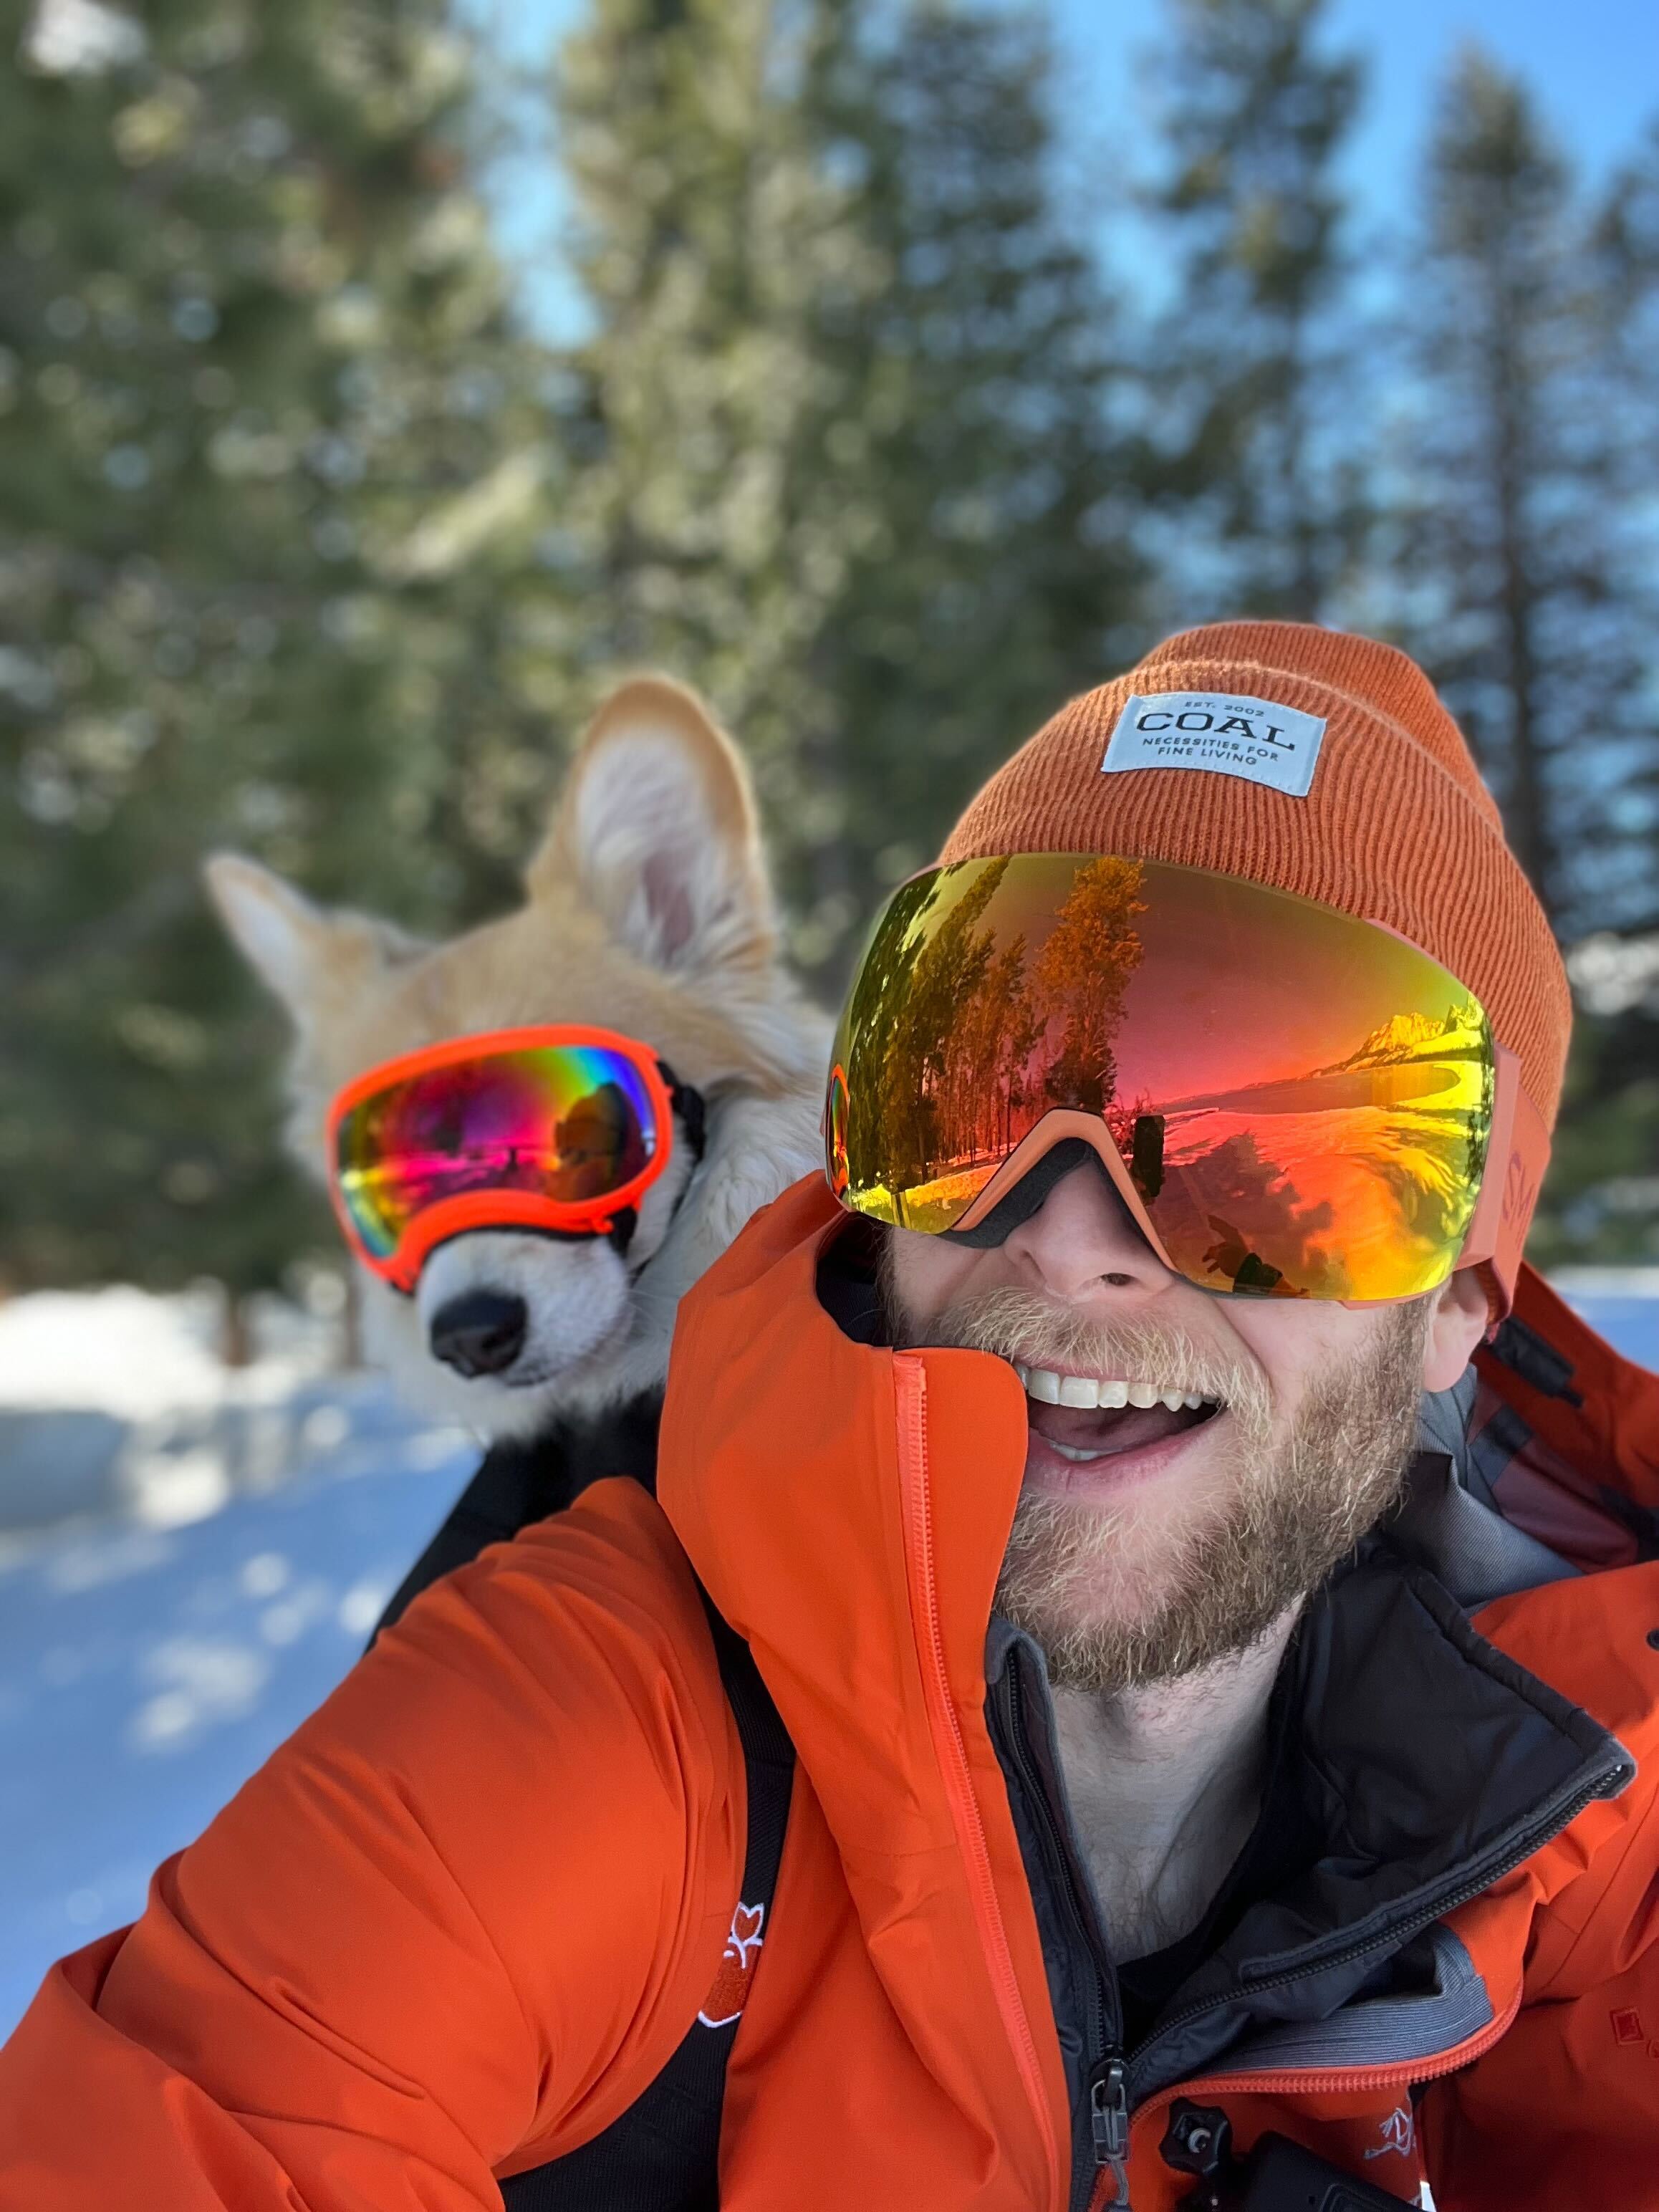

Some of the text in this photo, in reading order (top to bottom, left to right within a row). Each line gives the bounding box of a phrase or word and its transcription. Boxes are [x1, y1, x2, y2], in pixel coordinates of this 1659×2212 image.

[1223, 705, 1264, 717] 2002
[1137, 712, 1295, 751] COAL
[1143, 737, 1278, 761] NECESSITIES FOR
[1158, 746, 1256, 765] FINE LIVING
